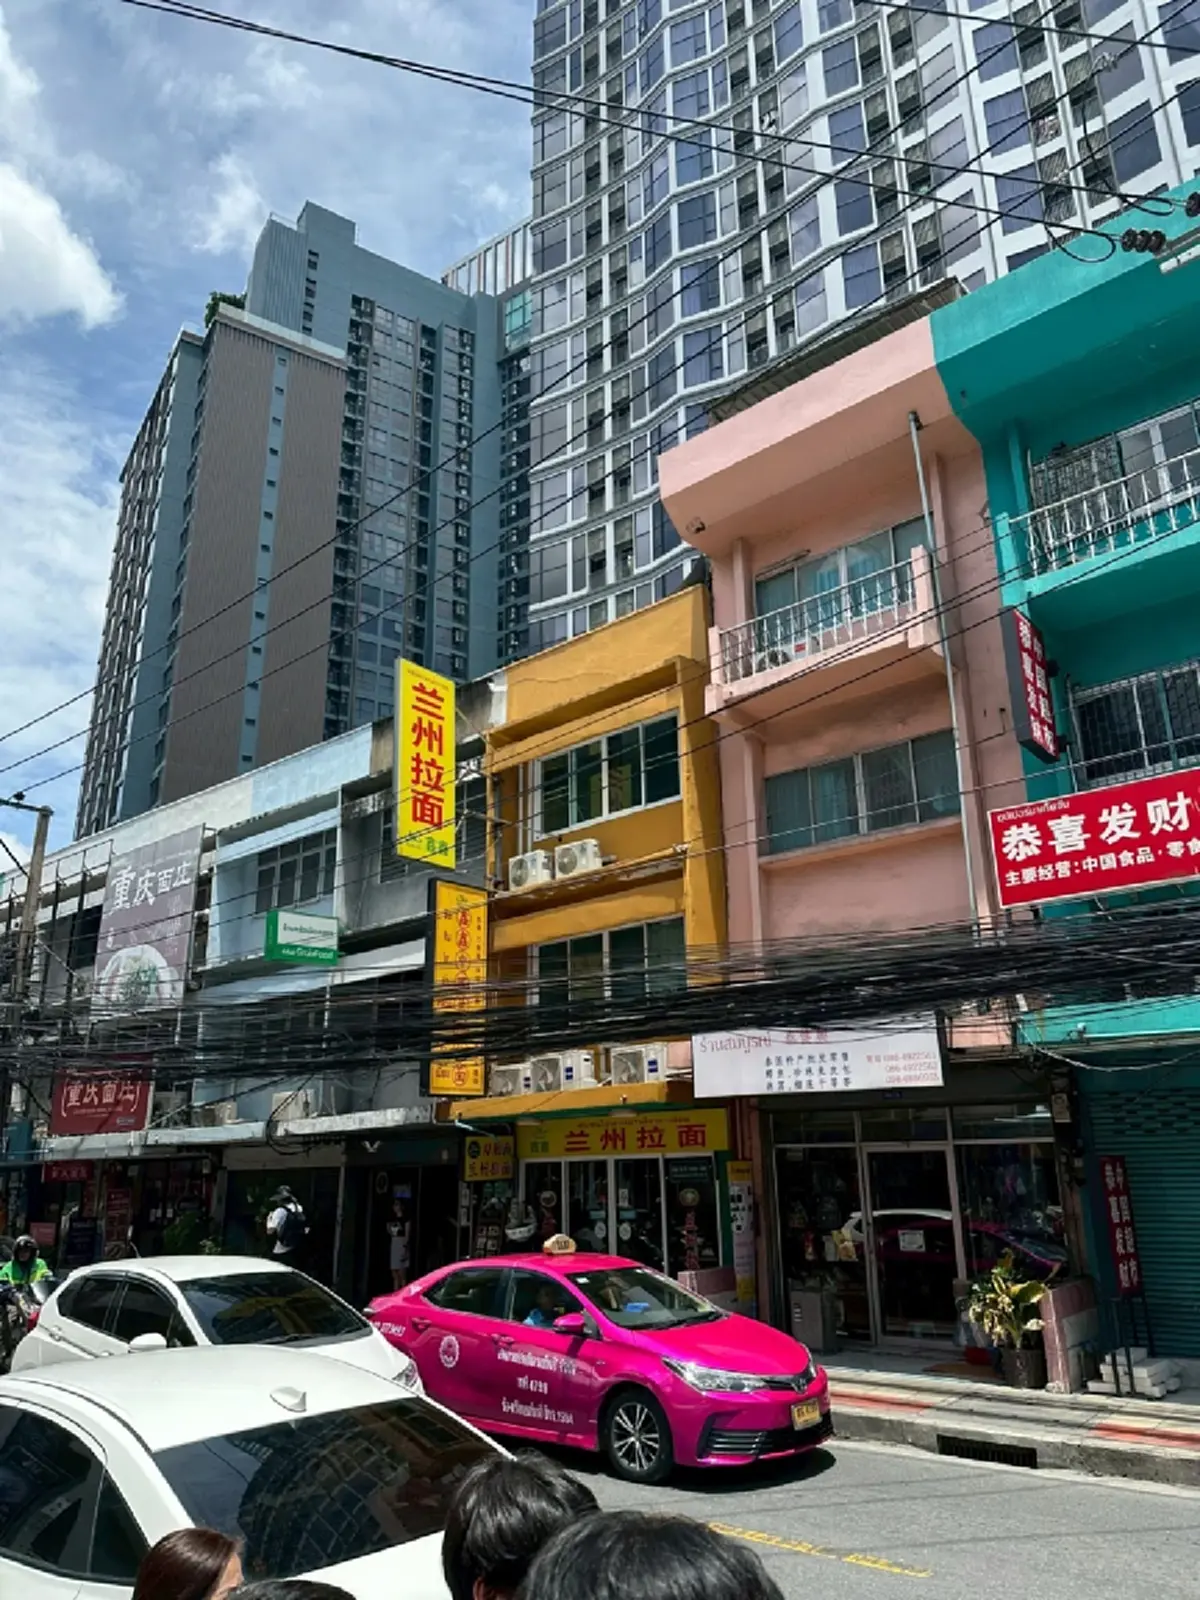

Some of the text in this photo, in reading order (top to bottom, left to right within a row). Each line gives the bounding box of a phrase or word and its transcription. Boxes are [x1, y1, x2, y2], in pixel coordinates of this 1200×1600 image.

[411, 681, 445, 829] 兰州拉面
[1002, 791, 1192, 862] 恭喜发财
[111, 862, 192, 910] 重庆面庄
[565, 1123, 707, 1152] 兰州拉面
